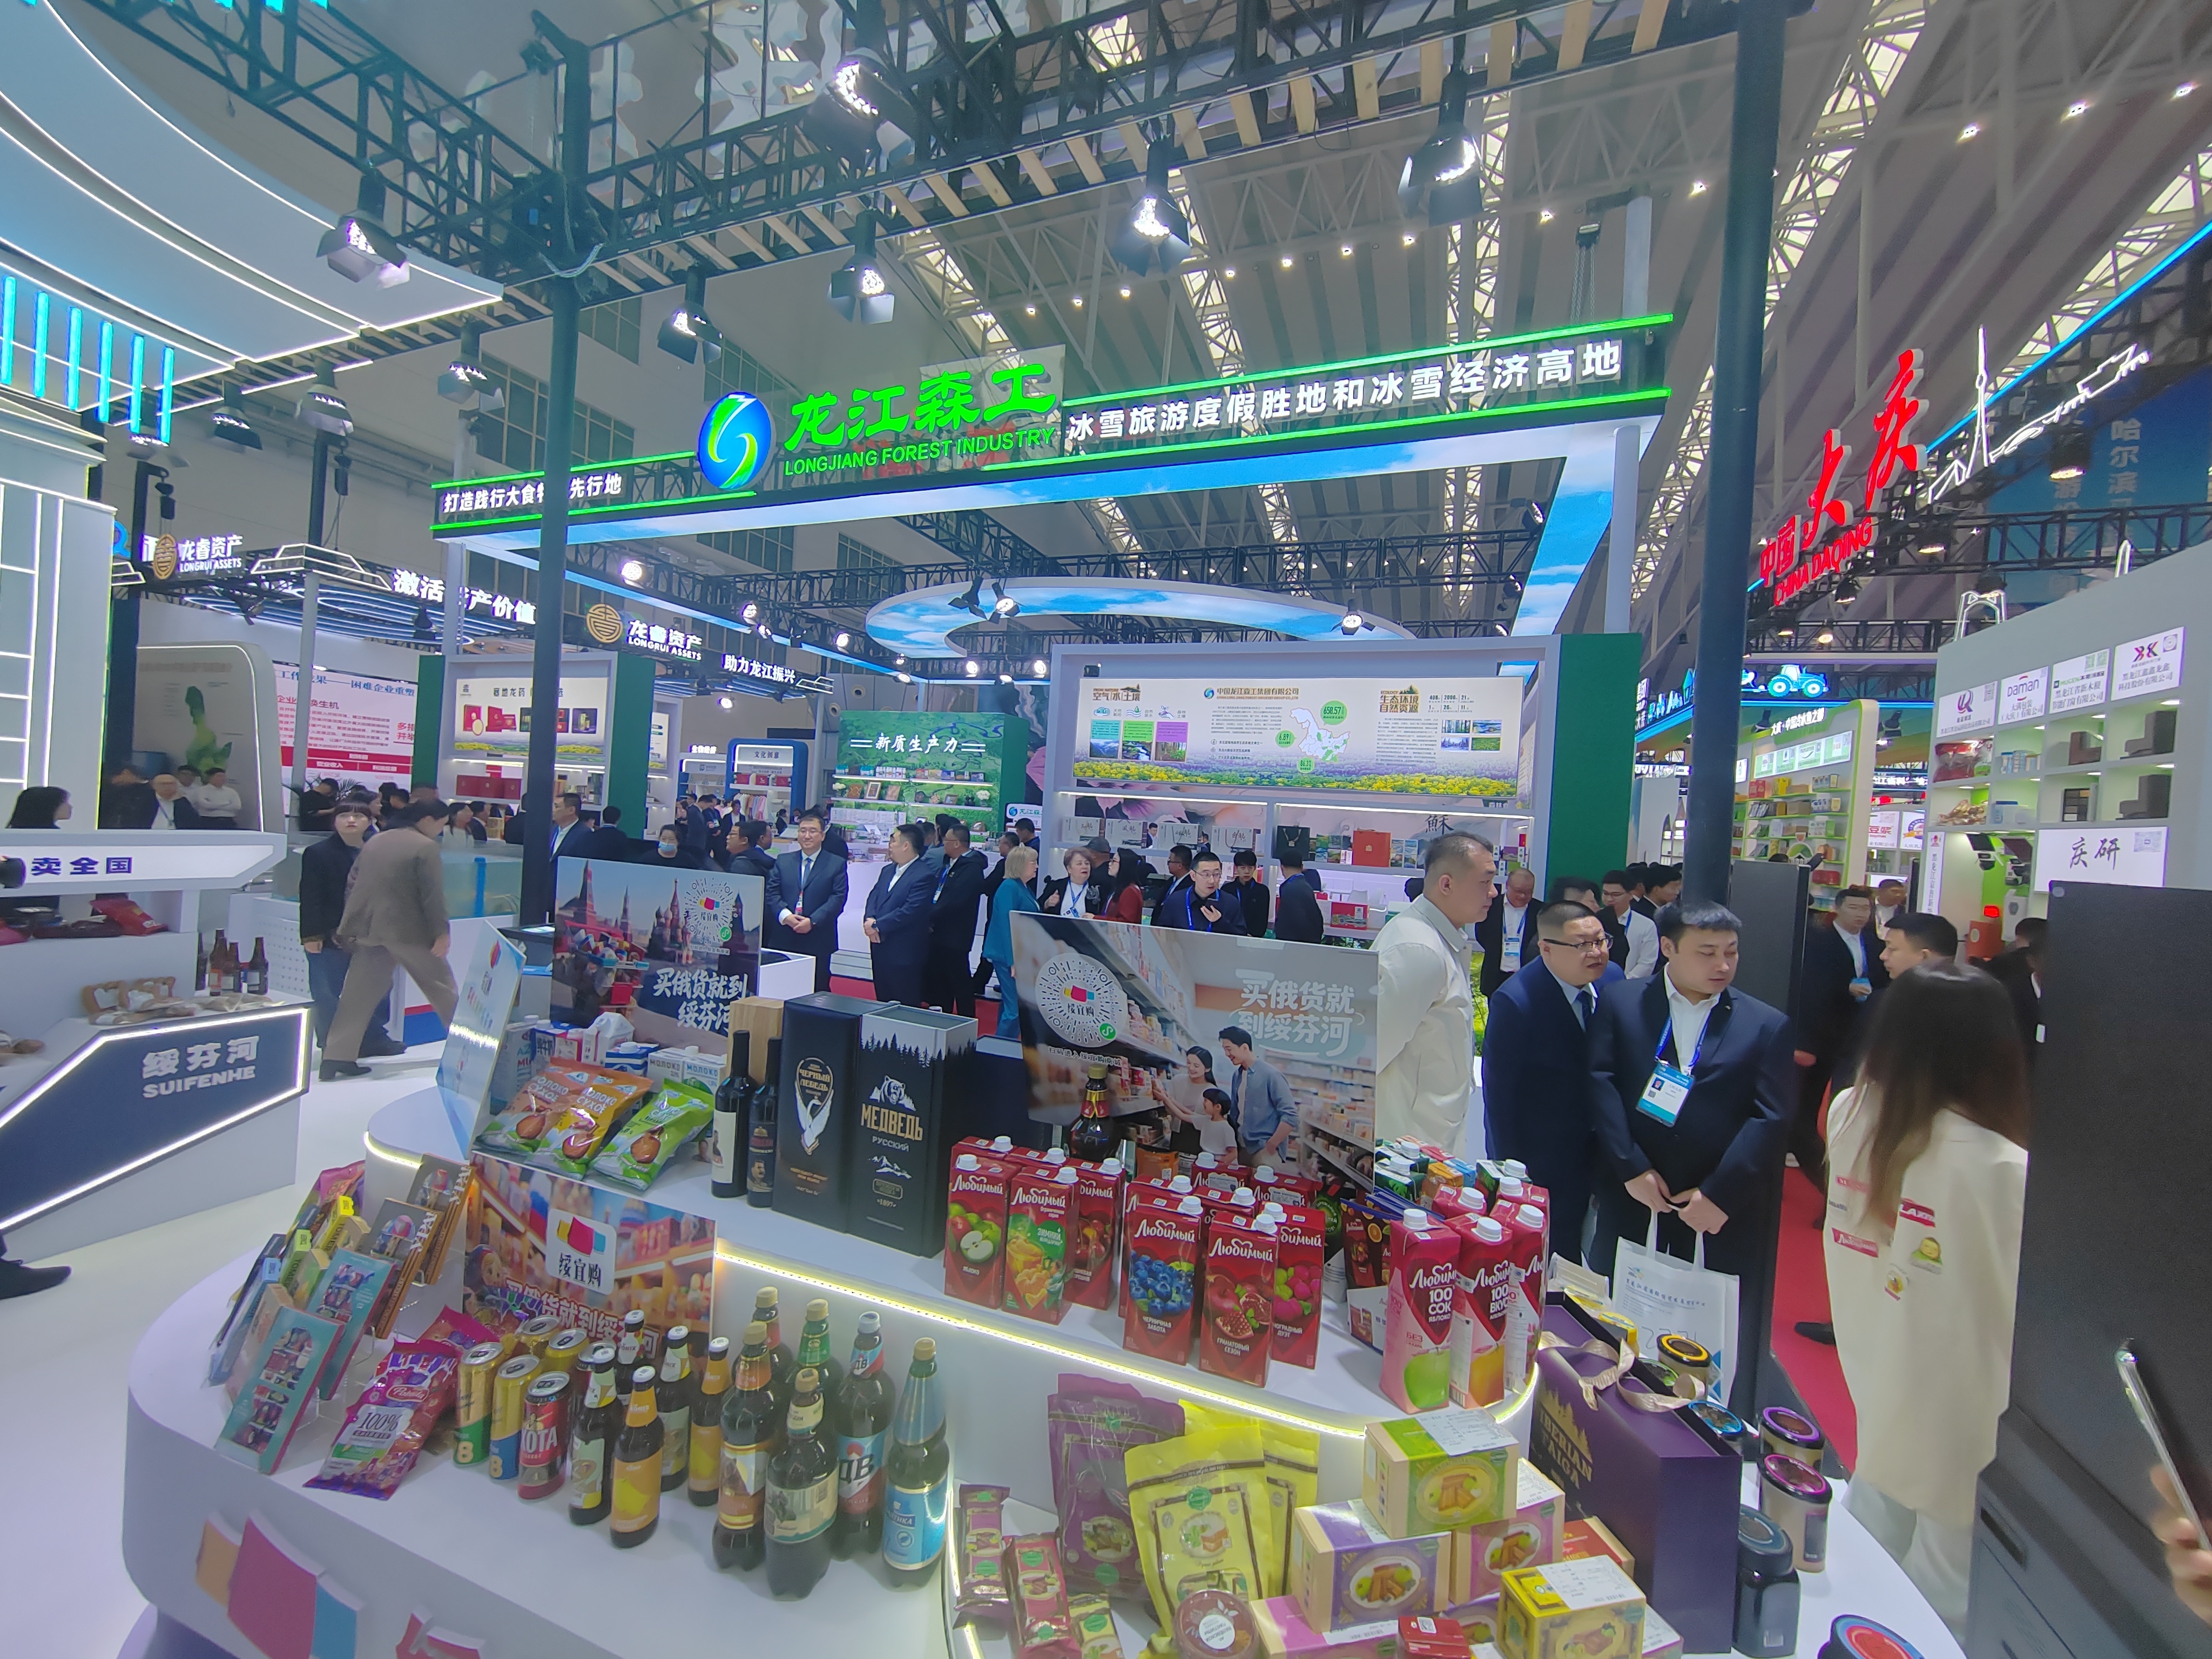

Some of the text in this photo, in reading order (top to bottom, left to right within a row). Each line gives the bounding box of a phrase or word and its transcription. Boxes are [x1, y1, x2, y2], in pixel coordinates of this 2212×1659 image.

[1067, 339, 1620, 441] 冰雪旅游度假胜地和冰雪经济高地
[784, 363, 1056, 451] 龙江森工
[785, 427, 1055, 475] LONGJIANG FOREST INDUSTRY
[2108, 417, 2141, 513] 哈尔滨
[443, 473, 622, 513] 打造践行大食先行地
[180, 535, 243, 561] 龙睿资产
[179, 558, 242, 572] LONGRUI ASSETS
[1773, 517, 1873, 606] CHINA DAQING
[393, 569, 536, 624] 激活产价值
[628, 619, 702, 649] 龙睿资产
[628, 636, 702, 660] LONGRUI ASSETS
[723, 653, 796, 684] 助力龙江振兴
[1217, 687, 1299, 696] 中国龙江森工集团有限公司
[1380, 694, 1419, 704] 生态环境
[1323, 706, 1341, 715] 658.57
[1380, 704, 1419, 713] 自然资源
[875, 732, 959, 754] 新质生产力
[754, 751, 780, 759] 文化创意
[2069, 837, 2121, 870] 庆研
[31, 857, 133, 876] 卖全国
[653, 968, 749, 1000] 买俄货就到
[1240, 980, 1355, 1015] 买俄货就
[1067, 1002, 1095, 1018] 绥宜购
[1237, 1010, 1354, 1057] 到绥芬河
[142, 1035, 260, 1079] 绥芬河
[649, 1058, 680, 1071] МОЛОКО
[1048, 1046, 1123, 1067] 扫码进入绥宜购商城
[686, 1063, 719, 1077] МОЛОКО
[143, 1065, 256, 1098] SUIFENHE
[860, 1103, 923, 1141] МЕДВЕДЬ
[872, 1136, 909, 1152] РУССКИЙ
[951, 1174, 1003, 1195] Любимый
[1080, 1179, 1114, 1199] бимый
[1010, 1187, 1066, 1208] Любимый
[1134, 1219, 1196, 1243] Любимый
[1280, 1226, 1322, 1247] бимый
[1209, 1237, 1274, 1263] Любимый
[559, 1252, 602, 1288] 绥宜购
[1428, 1287, 1453, 1303] 100
[1428, 1300, 1452, 1315] СОК
[1143, 1316, 1171, 1328] ЧЕРНИЧНАЯ
[1147, 1323, 1166, 1333] ЗАБОТА
[1273, 1323, 1303, 1334] НОГРАДНЫЙ
[1216, 1337, 1250, 1351] ГРАНАТОВЫЙ
[1406, 1331, 1423, 1343] БЕЗ
[1224, 1346, 1241, 1356] СЕЗОН
[358, 1412, 403, 1432] 100%
[1540, 1409, 1592, 1482] IBERIAN
[839, 1454, 874, 1483] ДВ
